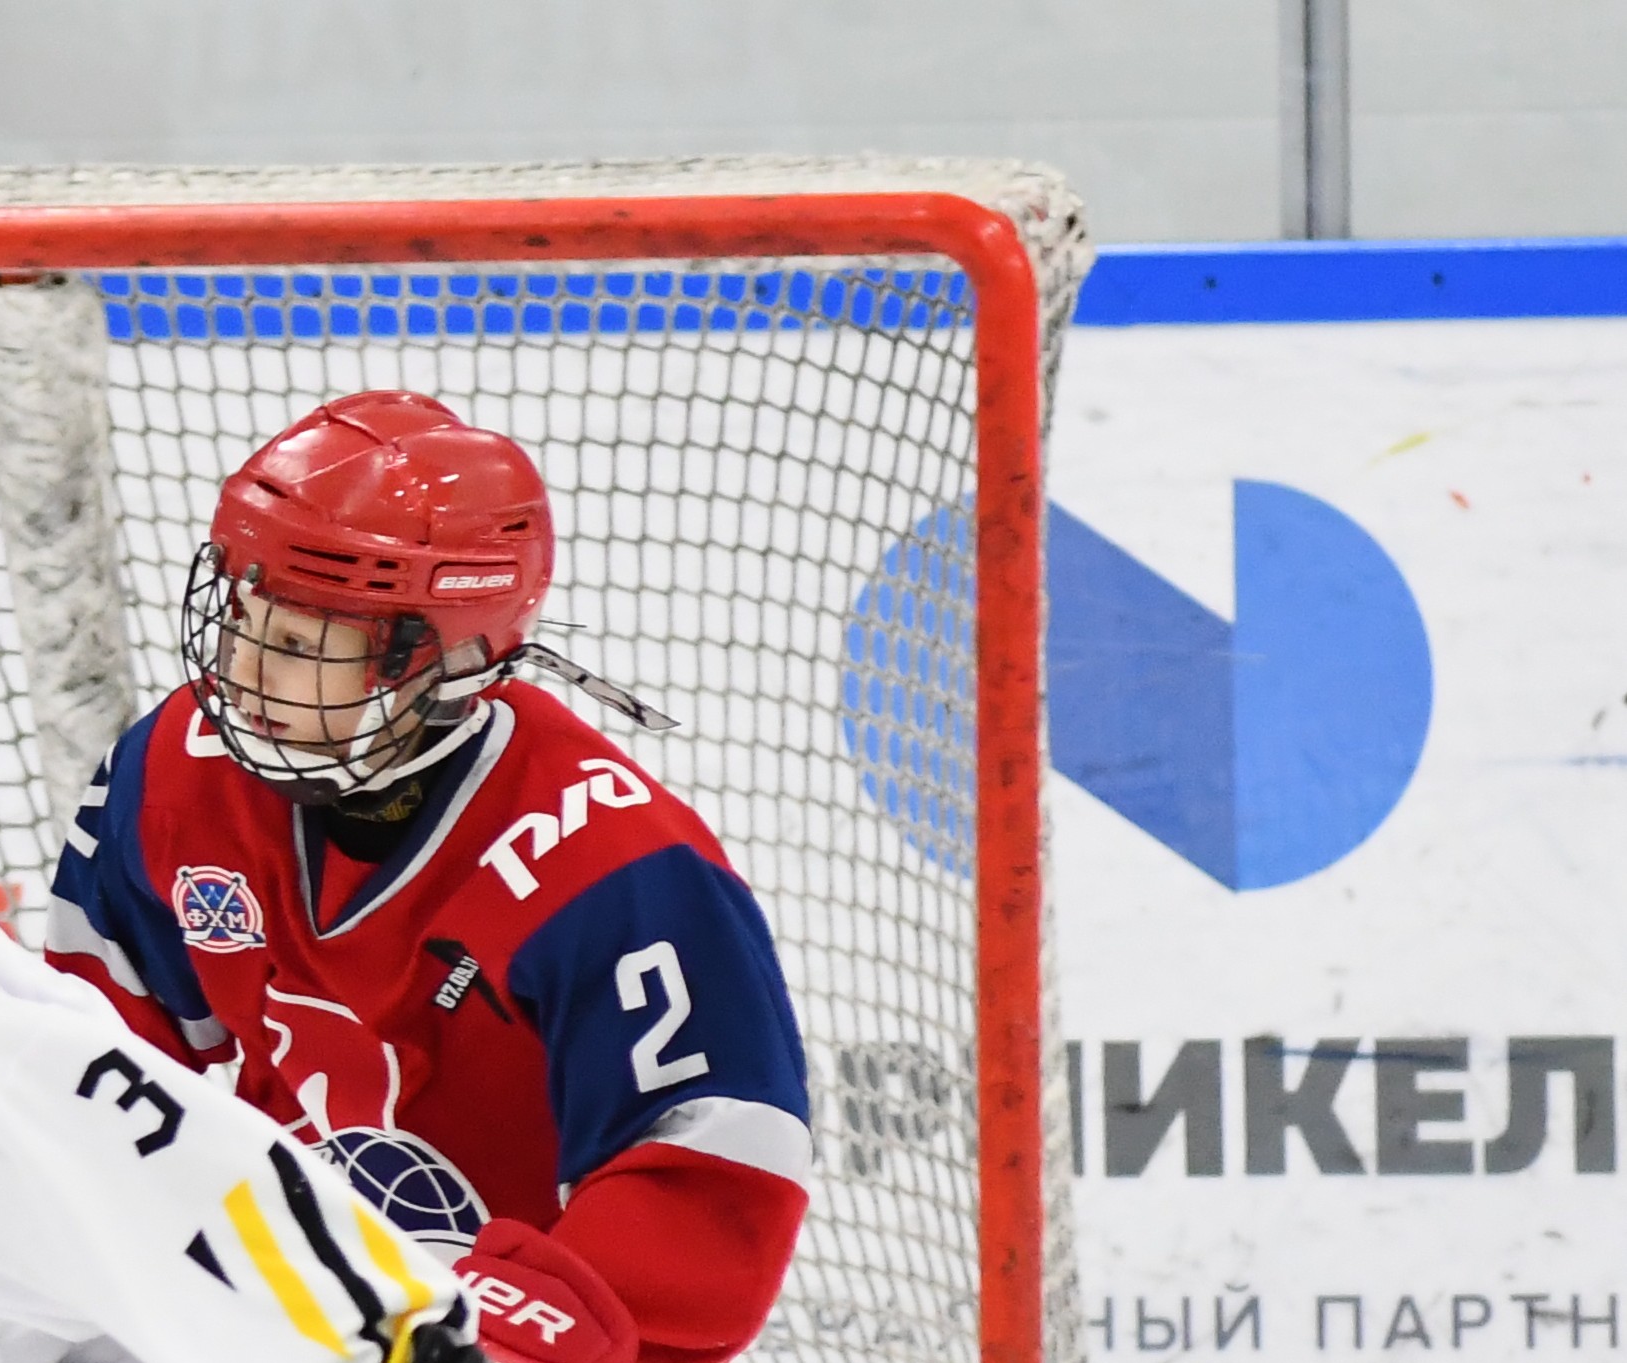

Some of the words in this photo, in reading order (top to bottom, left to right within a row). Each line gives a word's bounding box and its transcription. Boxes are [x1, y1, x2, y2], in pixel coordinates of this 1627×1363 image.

[185, 908, 249, 930] ФХМ
[434, 954, 480, 1010] 07.09.11
[615, 939, 710, 1094] 2
[76, 1047, 185, 1159] 3
